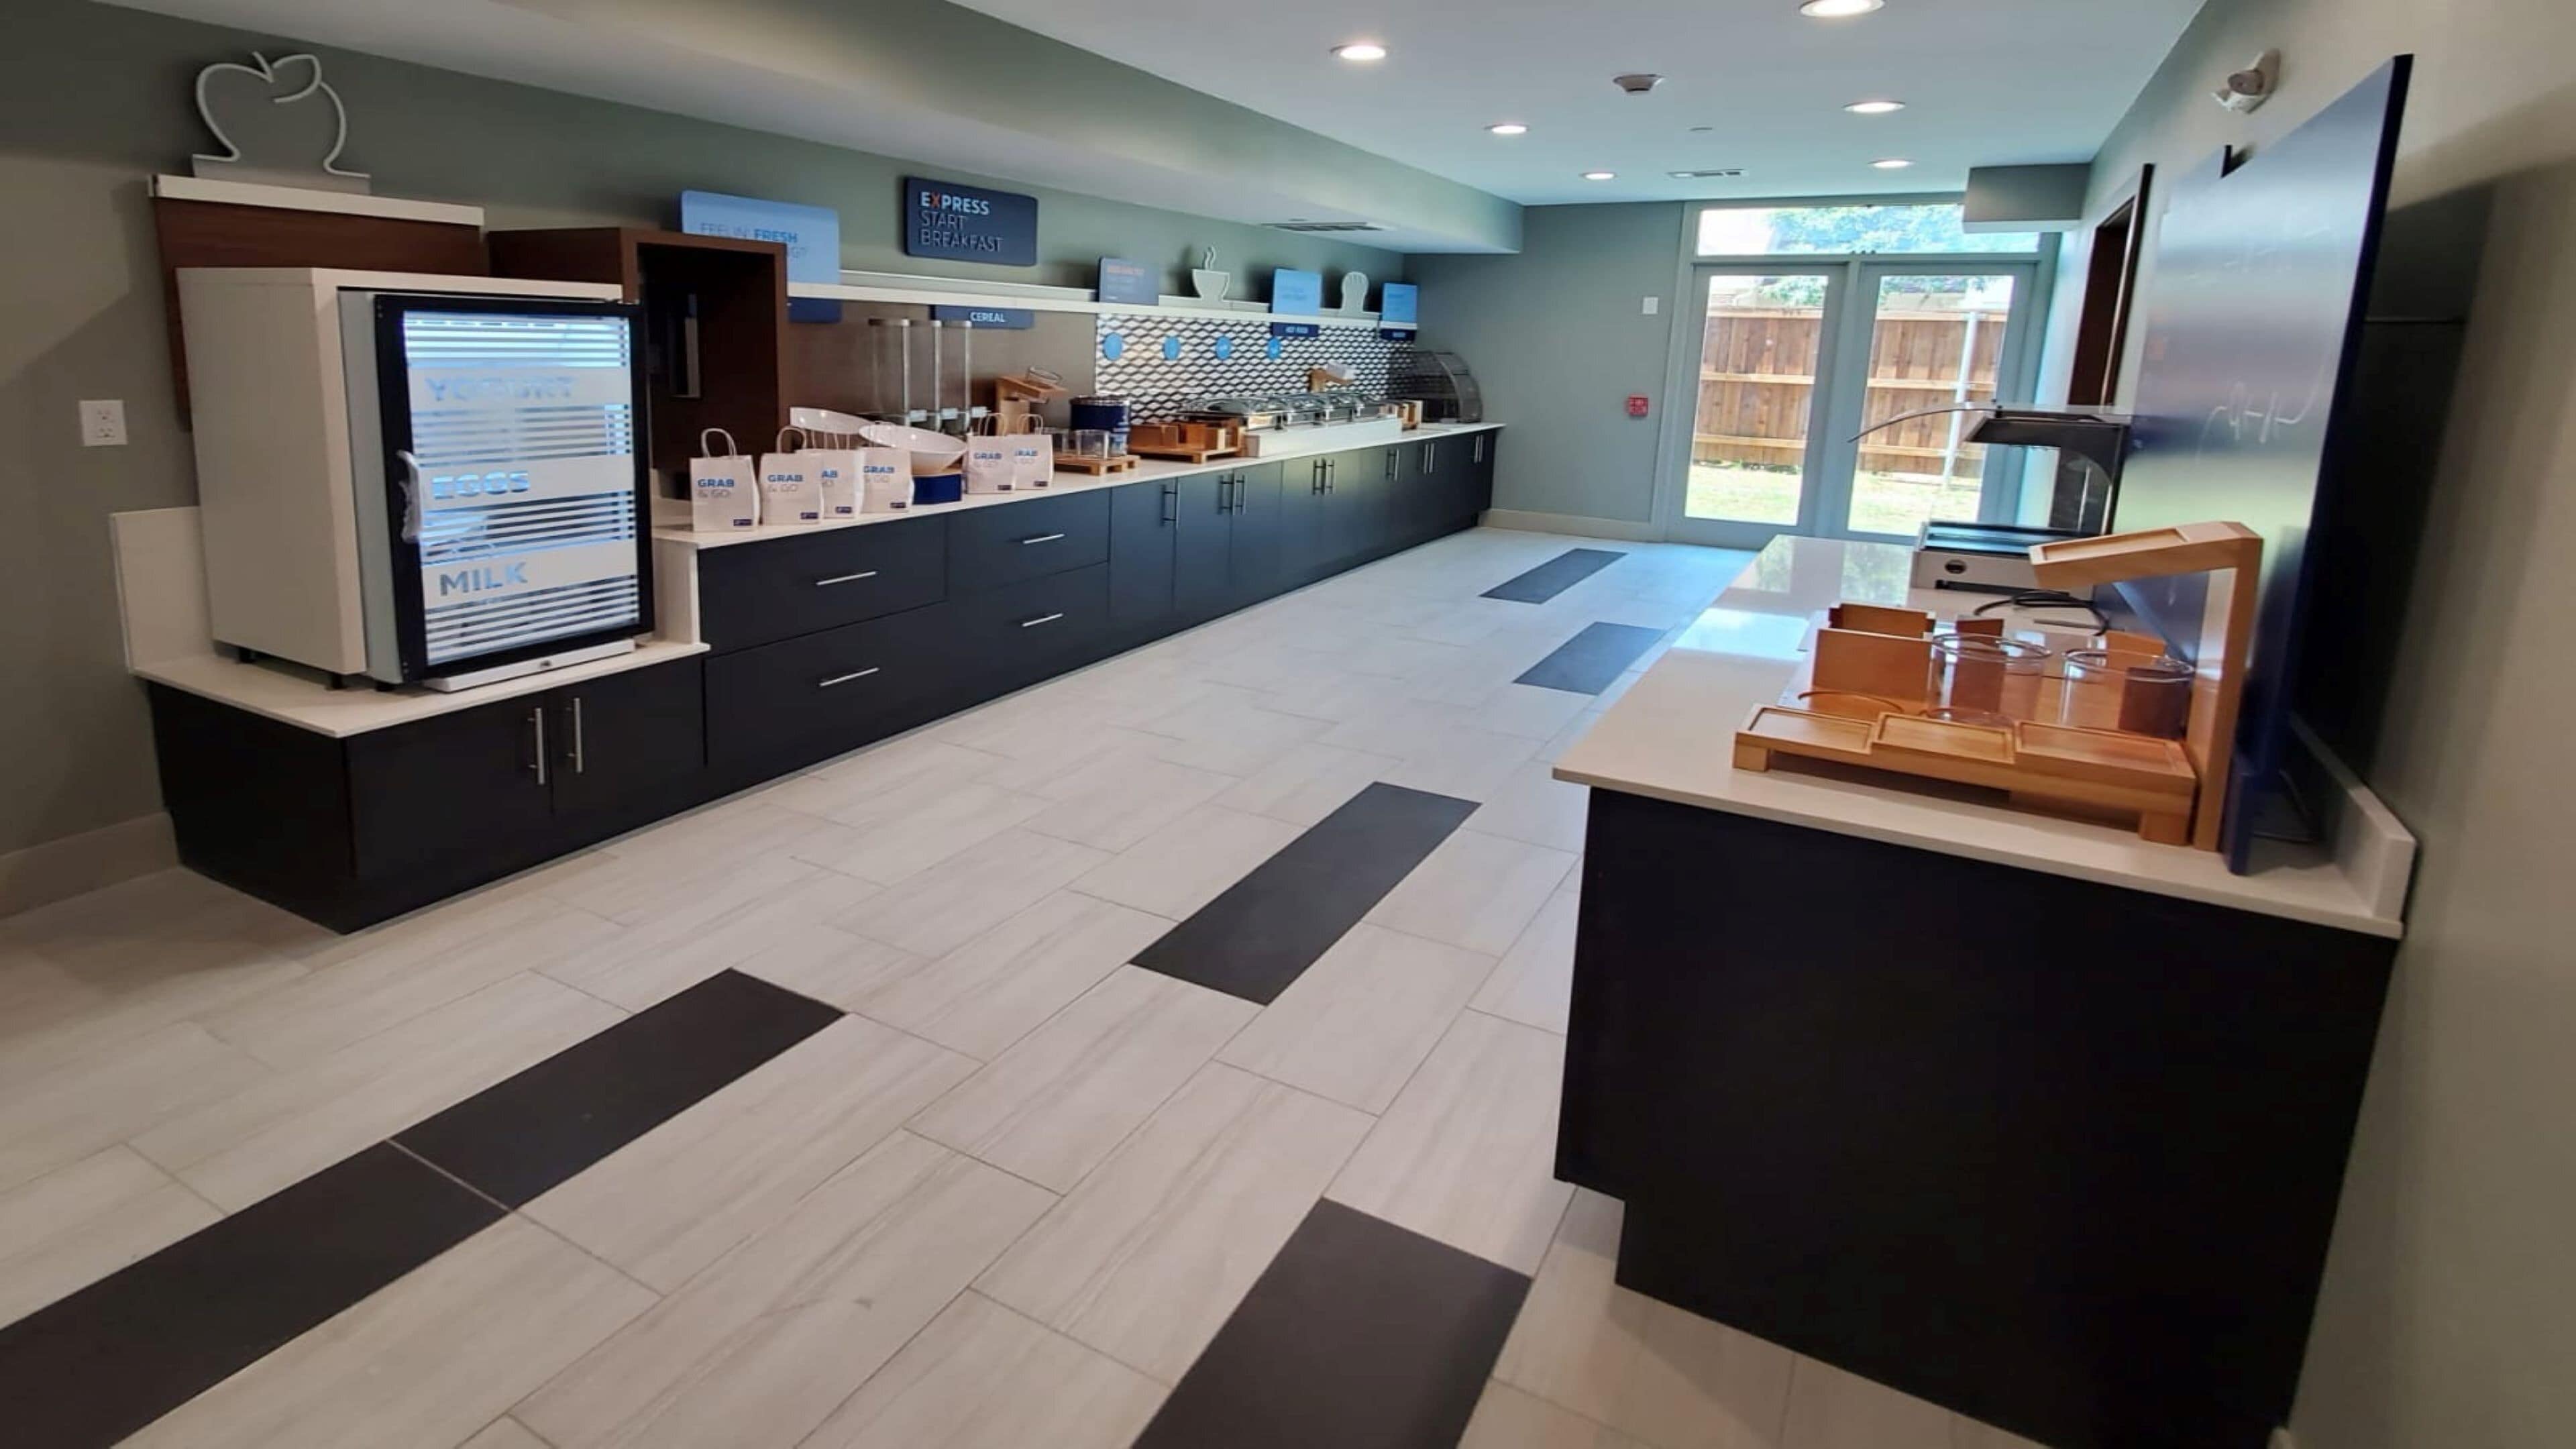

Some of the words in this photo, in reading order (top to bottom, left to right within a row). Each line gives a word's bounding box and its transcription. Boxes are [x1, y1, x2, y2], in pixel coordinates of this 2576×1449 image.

[921, 191, 990, 215] EXPRESS
[921, 211, 966, 230] START
[754, 229, 799, 244] FRESH
[921, 229, 1004, 253] BREAKFAST
[970, 311, 1005, 323] CEREAL
[432, 471, 531, 500] EGGS
[697, 478, 735, 488] GRAB
[767, 474, 803, 483] GRAB
[440, 561, 529, 596] MILK
